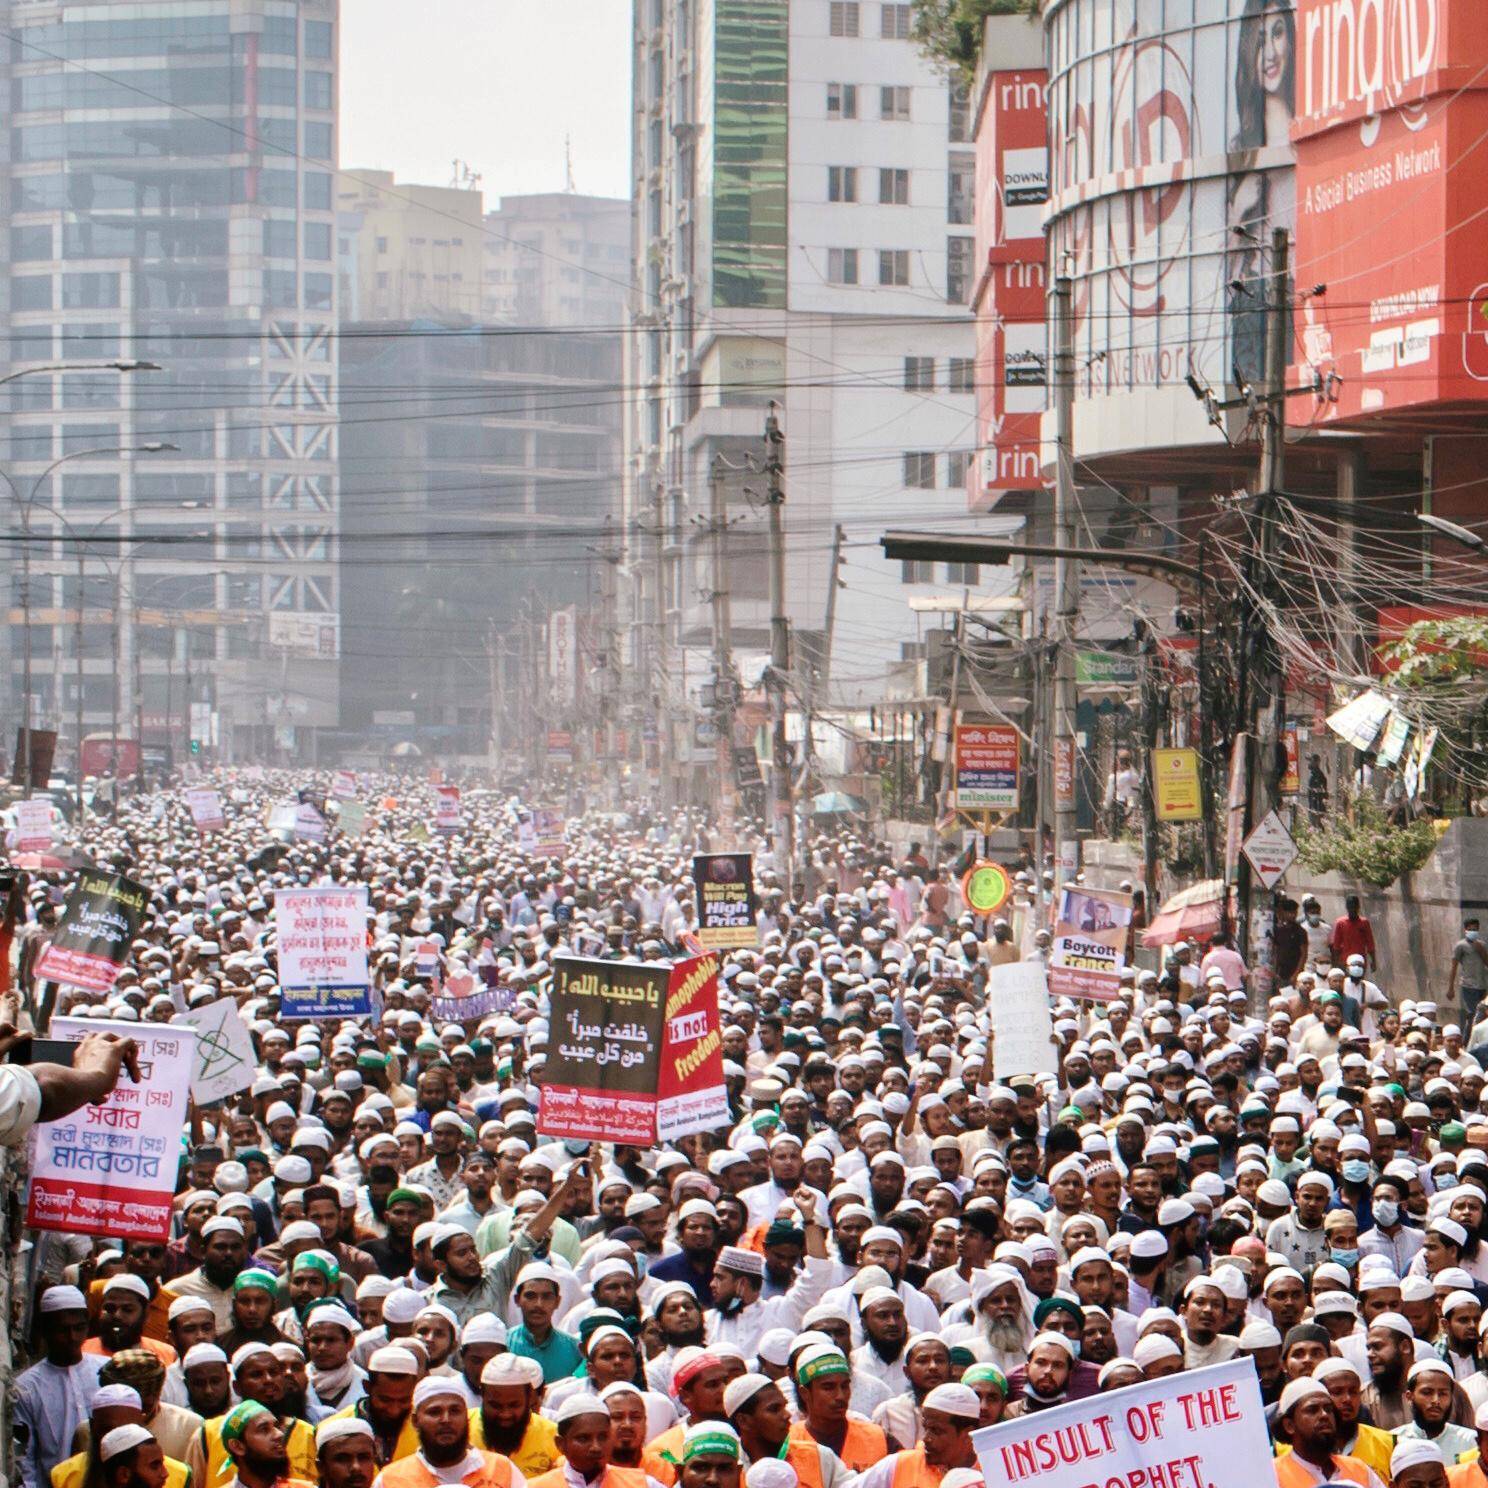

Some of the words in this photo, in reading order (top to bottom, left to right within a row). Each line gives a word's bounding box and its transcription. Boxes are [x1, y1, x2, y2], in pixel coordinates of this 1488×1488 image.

[1347, 161, 1392, 201] Business
[1396, 141, 1441, 180] Network
[706, 901, 748, 917] High
[706, 915, 750, 927] Price
[1063, 938, 1117, 958] Boycott
[1064, 954, 1116, 971] France
[570, 974, 599, 995] الله
[601, 984, 645, 1005] حبيب
[682, 1014, 708, 1037] not
[673, 1029, 721, 1082] Freedom
[86, 1105, 142, 1130] সবার
[51, 1124, 78, 1143] নবী
[52, 1145, 162, 1179] মানবতার
[107, 1217, 165, 1235] Bangladesh
[1001, 1411, 1122, 1482] INSULT
[1126, 1399, 1170, 1442] OF
[1177, 1384, 1245, 1426] THE
